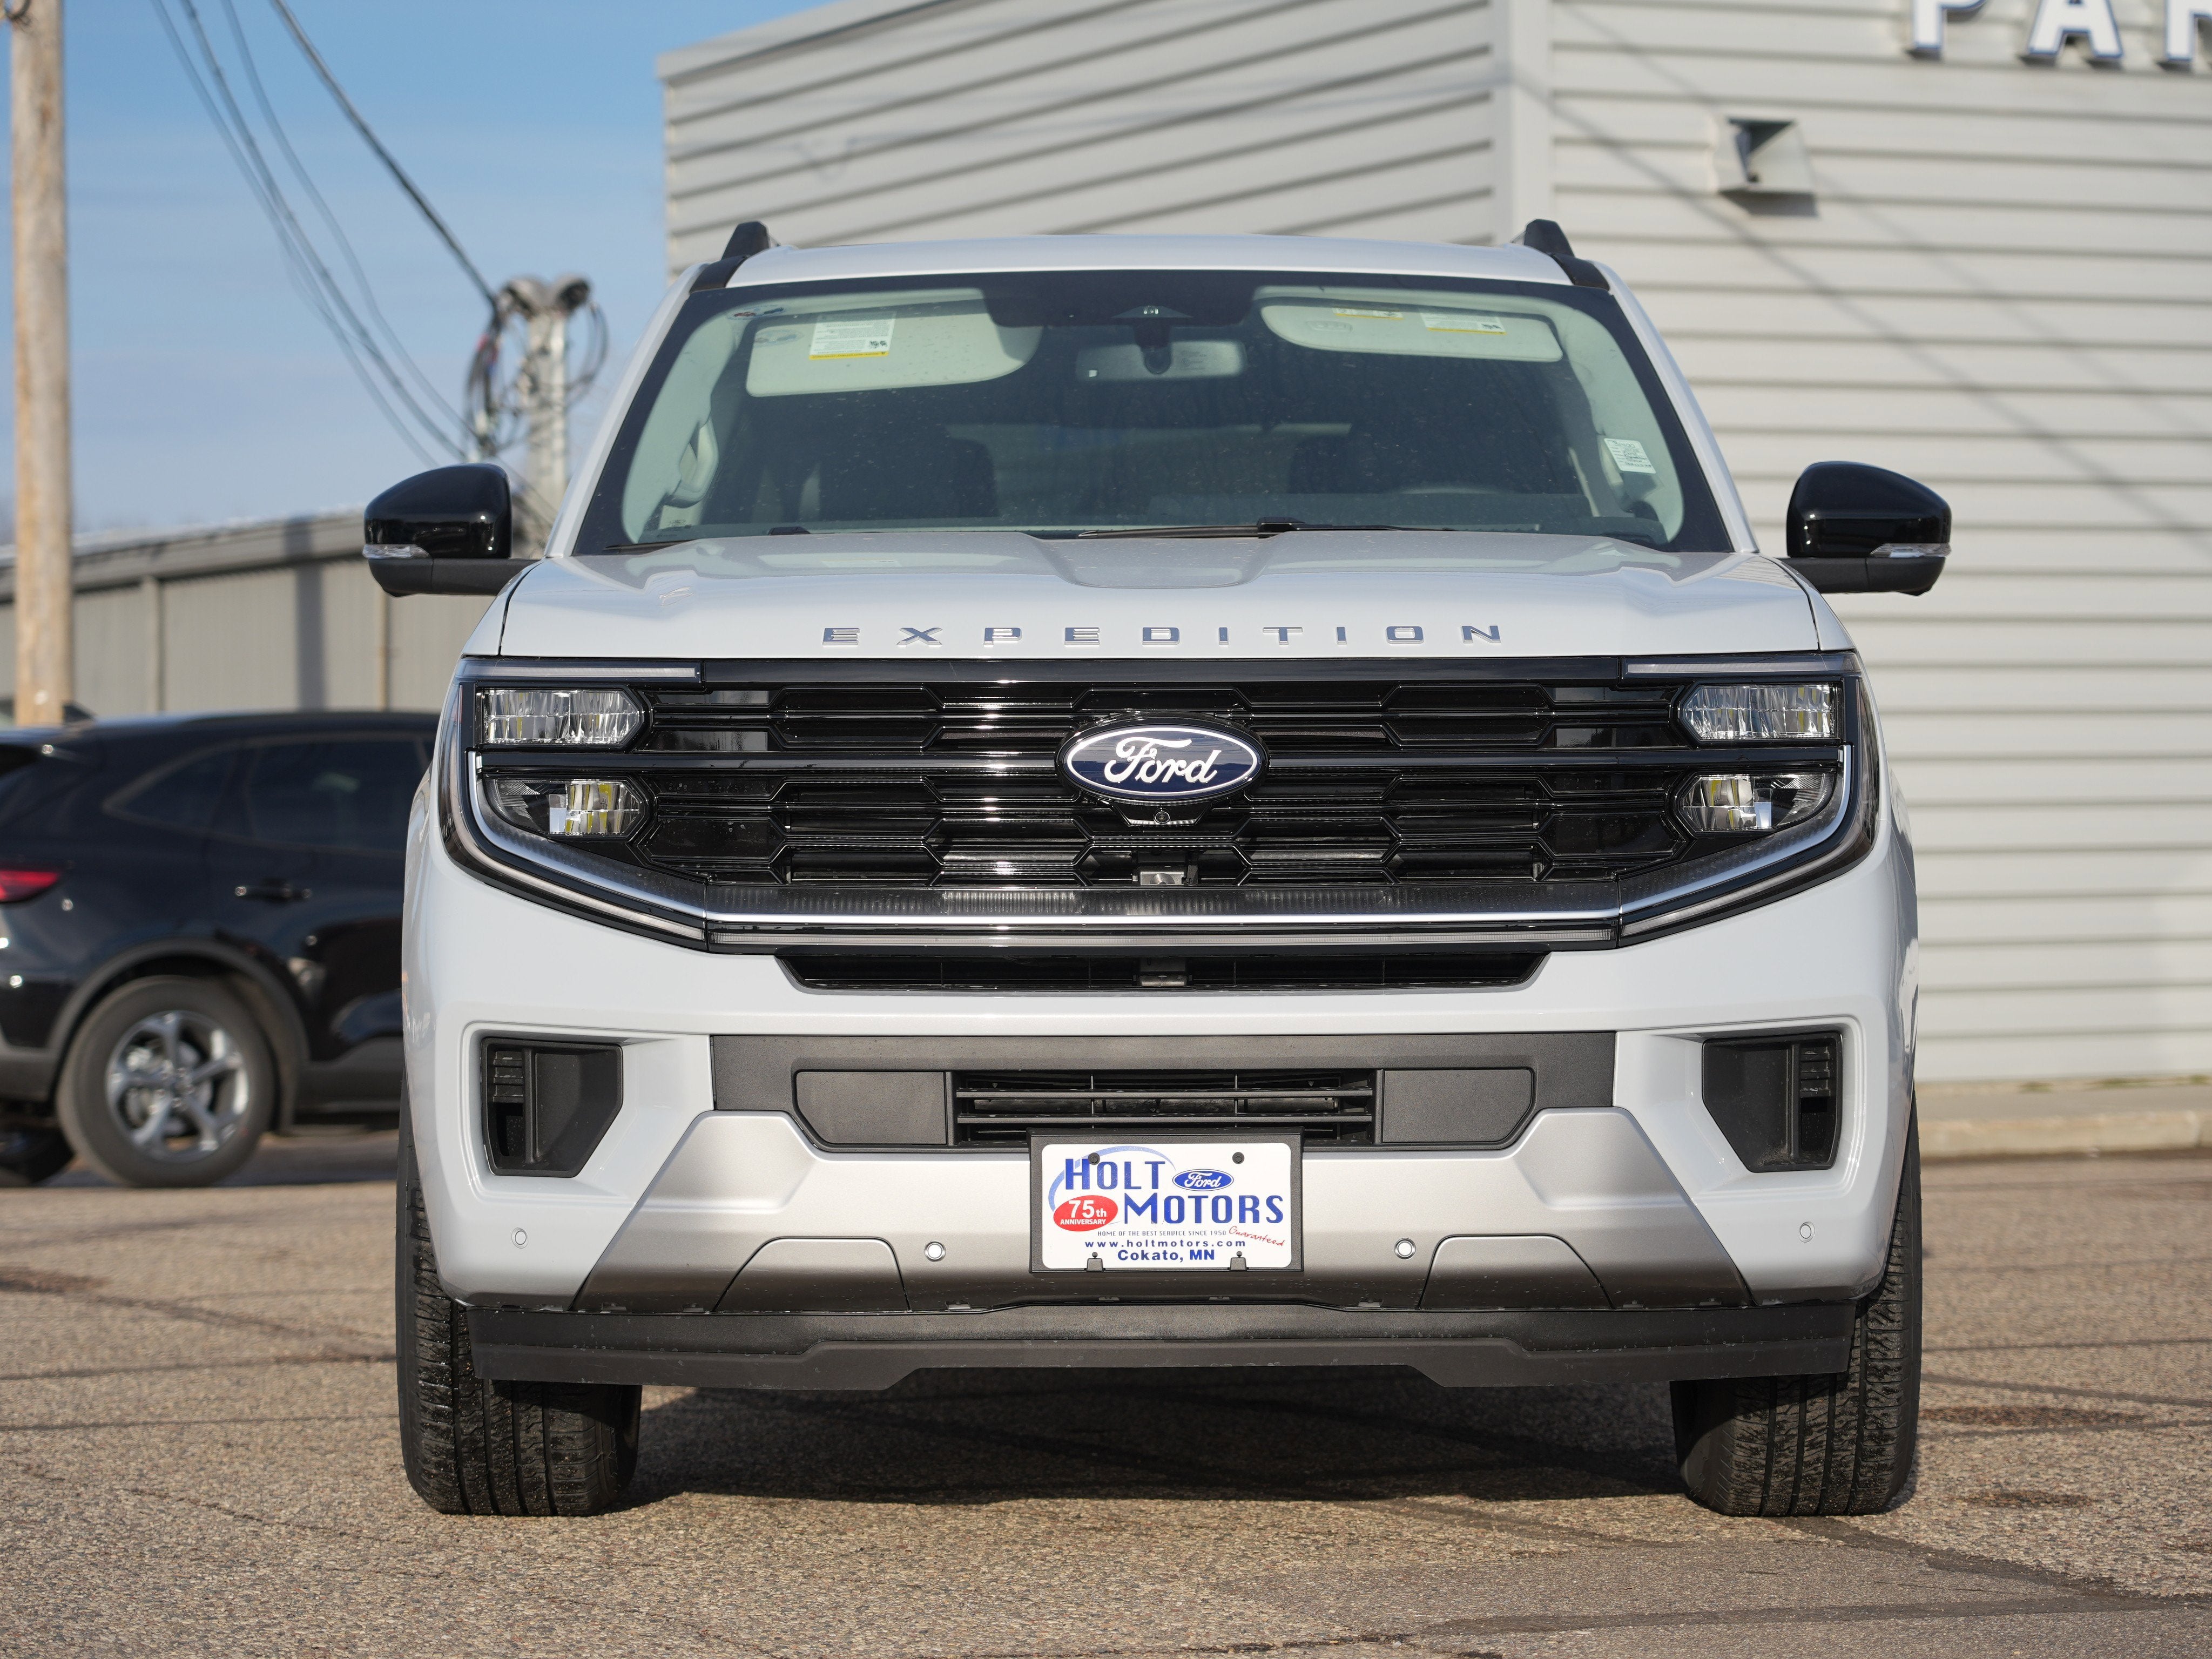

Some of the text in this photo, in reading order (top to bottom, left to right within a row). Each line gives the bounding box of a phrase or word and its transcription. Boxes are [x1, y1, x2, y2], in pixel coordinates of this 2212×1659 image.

[821, 625, 1502, 646] EXPEDITION
[1104, 736, 1222, 784] Ford
[1065, 1158, 1166, 1190] HOLT
[1184, 1171, 1222, 1188] Ford
[1068, 1199, 1108, 1218] 75th
[1124, 1192, 1284, 1224] MOTORS
[1085, 1239, 1245, 1247] www.holtmotors.com
[1229, 1225, 1285, 1247] Guaranteed
[1117, 1249, 1215, 1263] Cokato, MN
